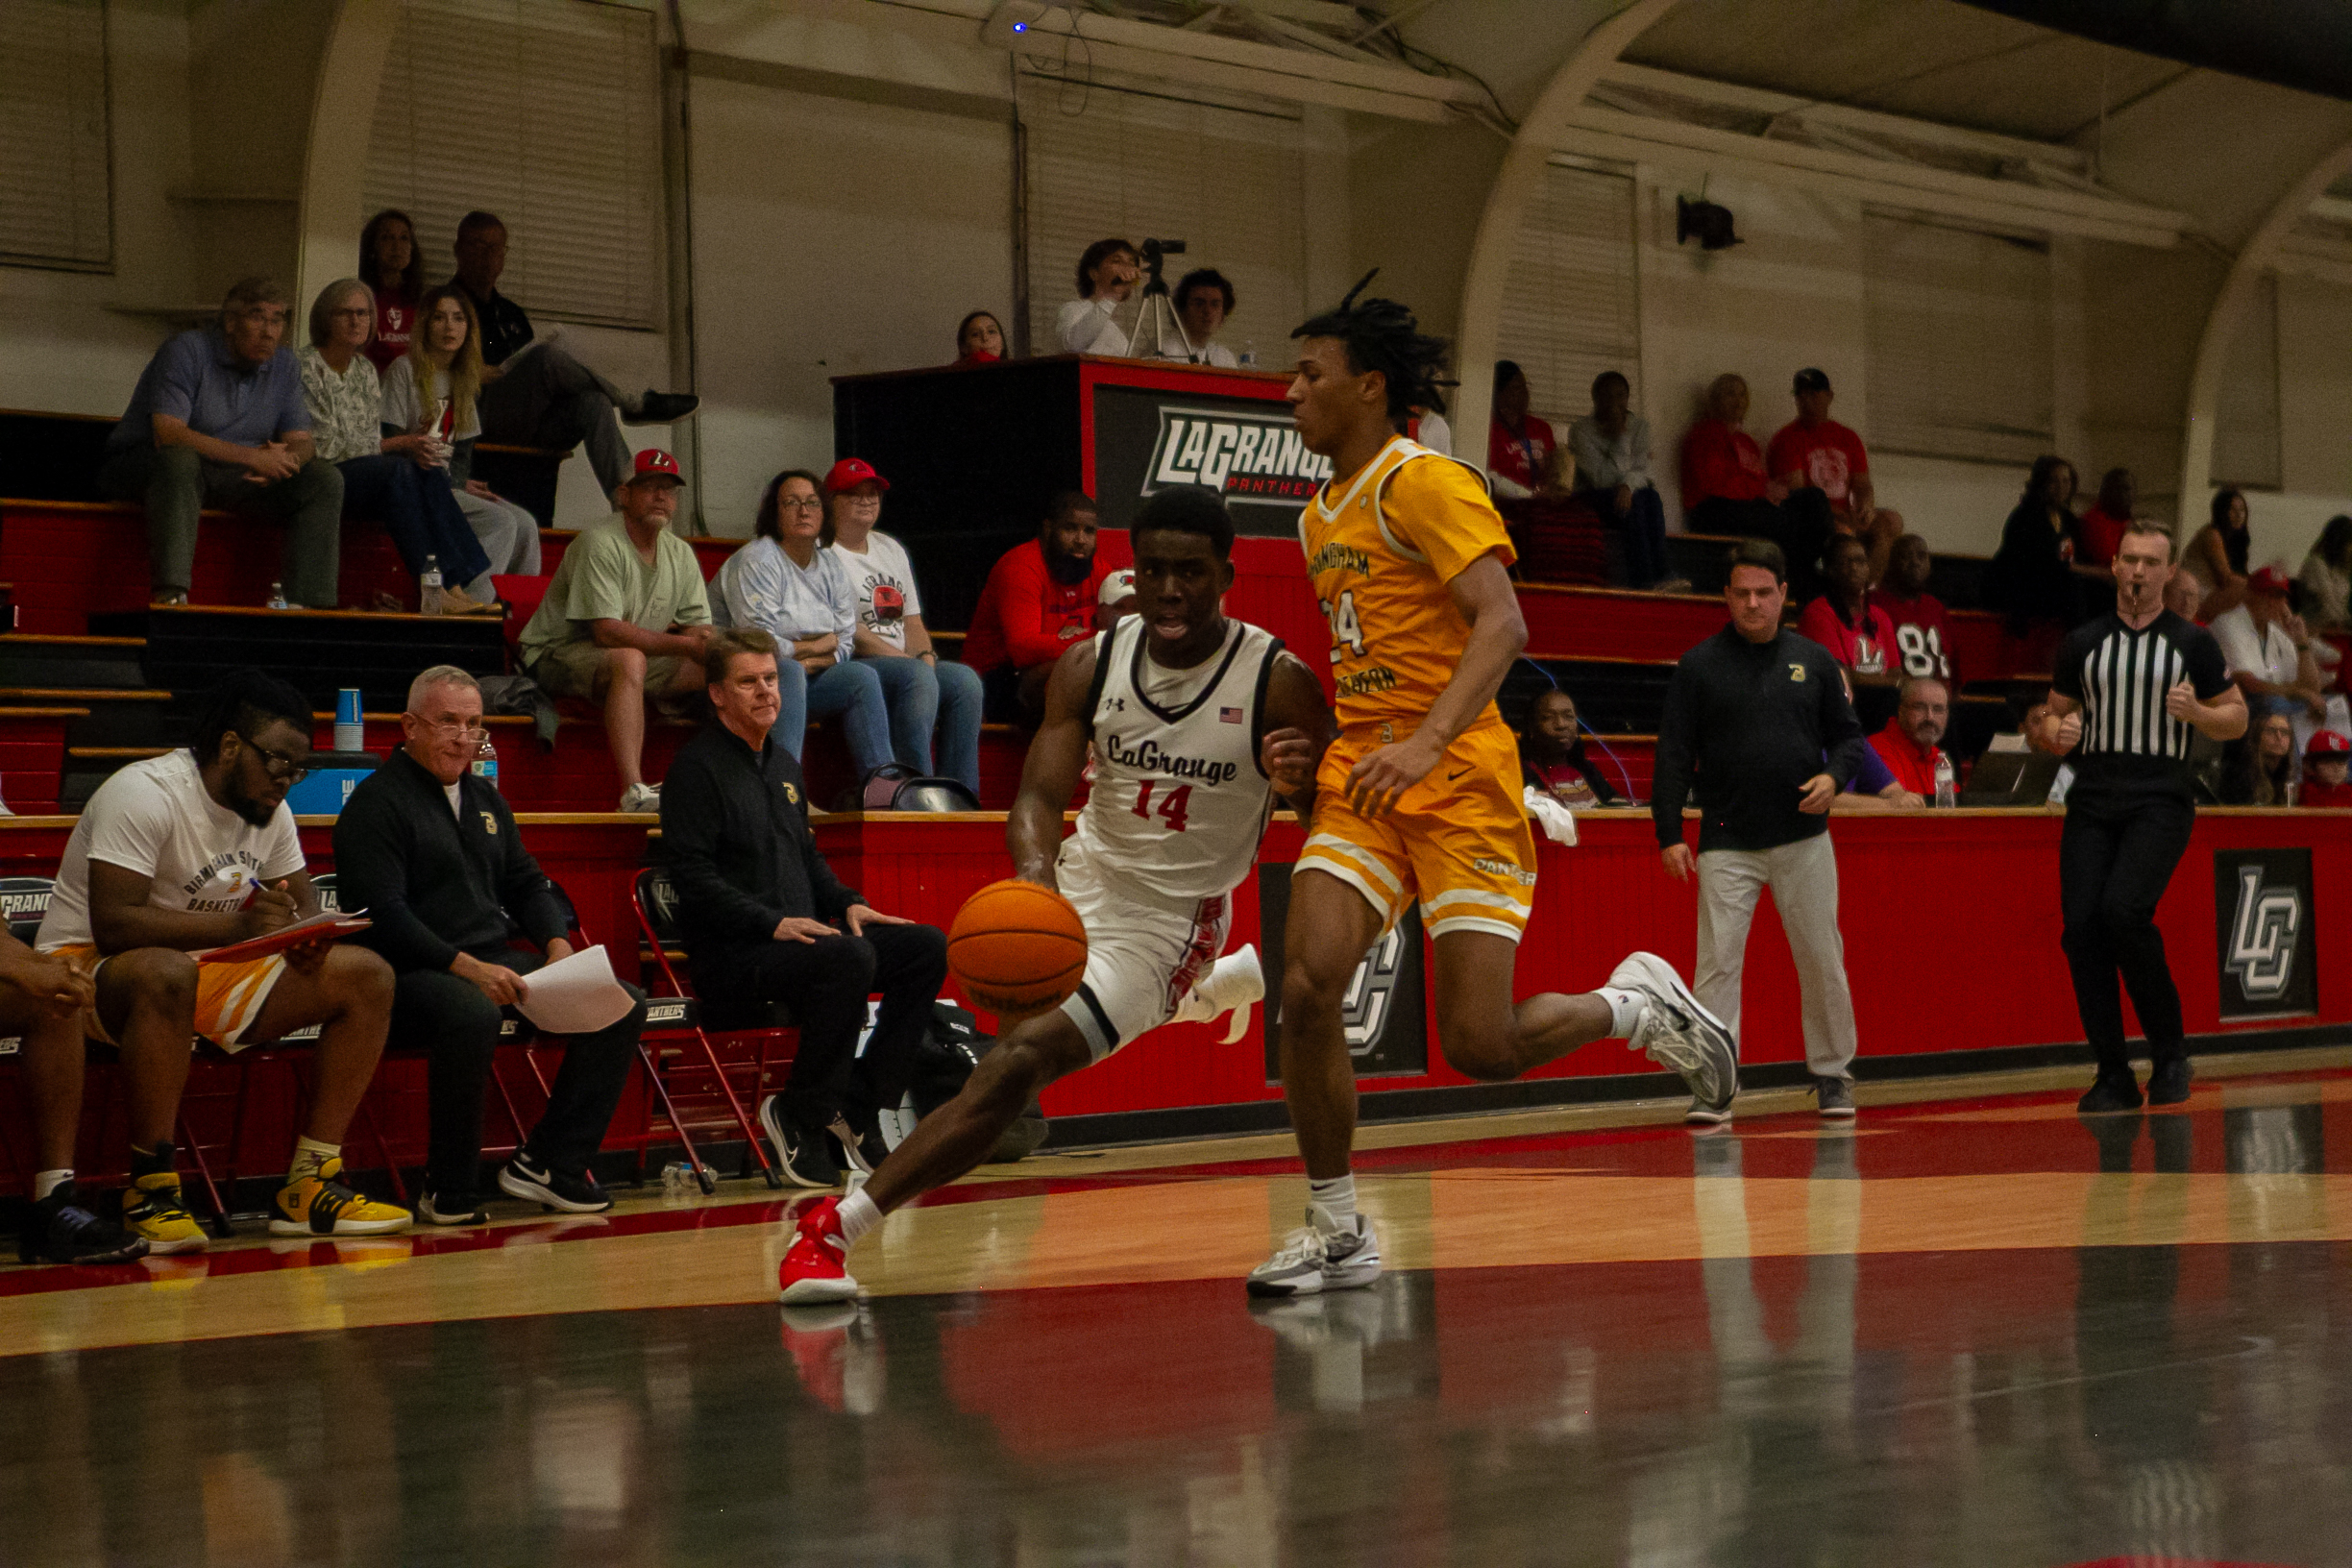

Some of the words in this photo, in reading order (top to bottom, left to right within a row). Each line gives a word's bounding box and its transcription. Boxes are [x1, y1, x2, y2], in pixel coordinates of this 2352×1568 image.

[1108, 734, 1237, 787] LaGrange
[1132, 779, 1193, 832] 14
[2225, 866, 2300, 999] LC
